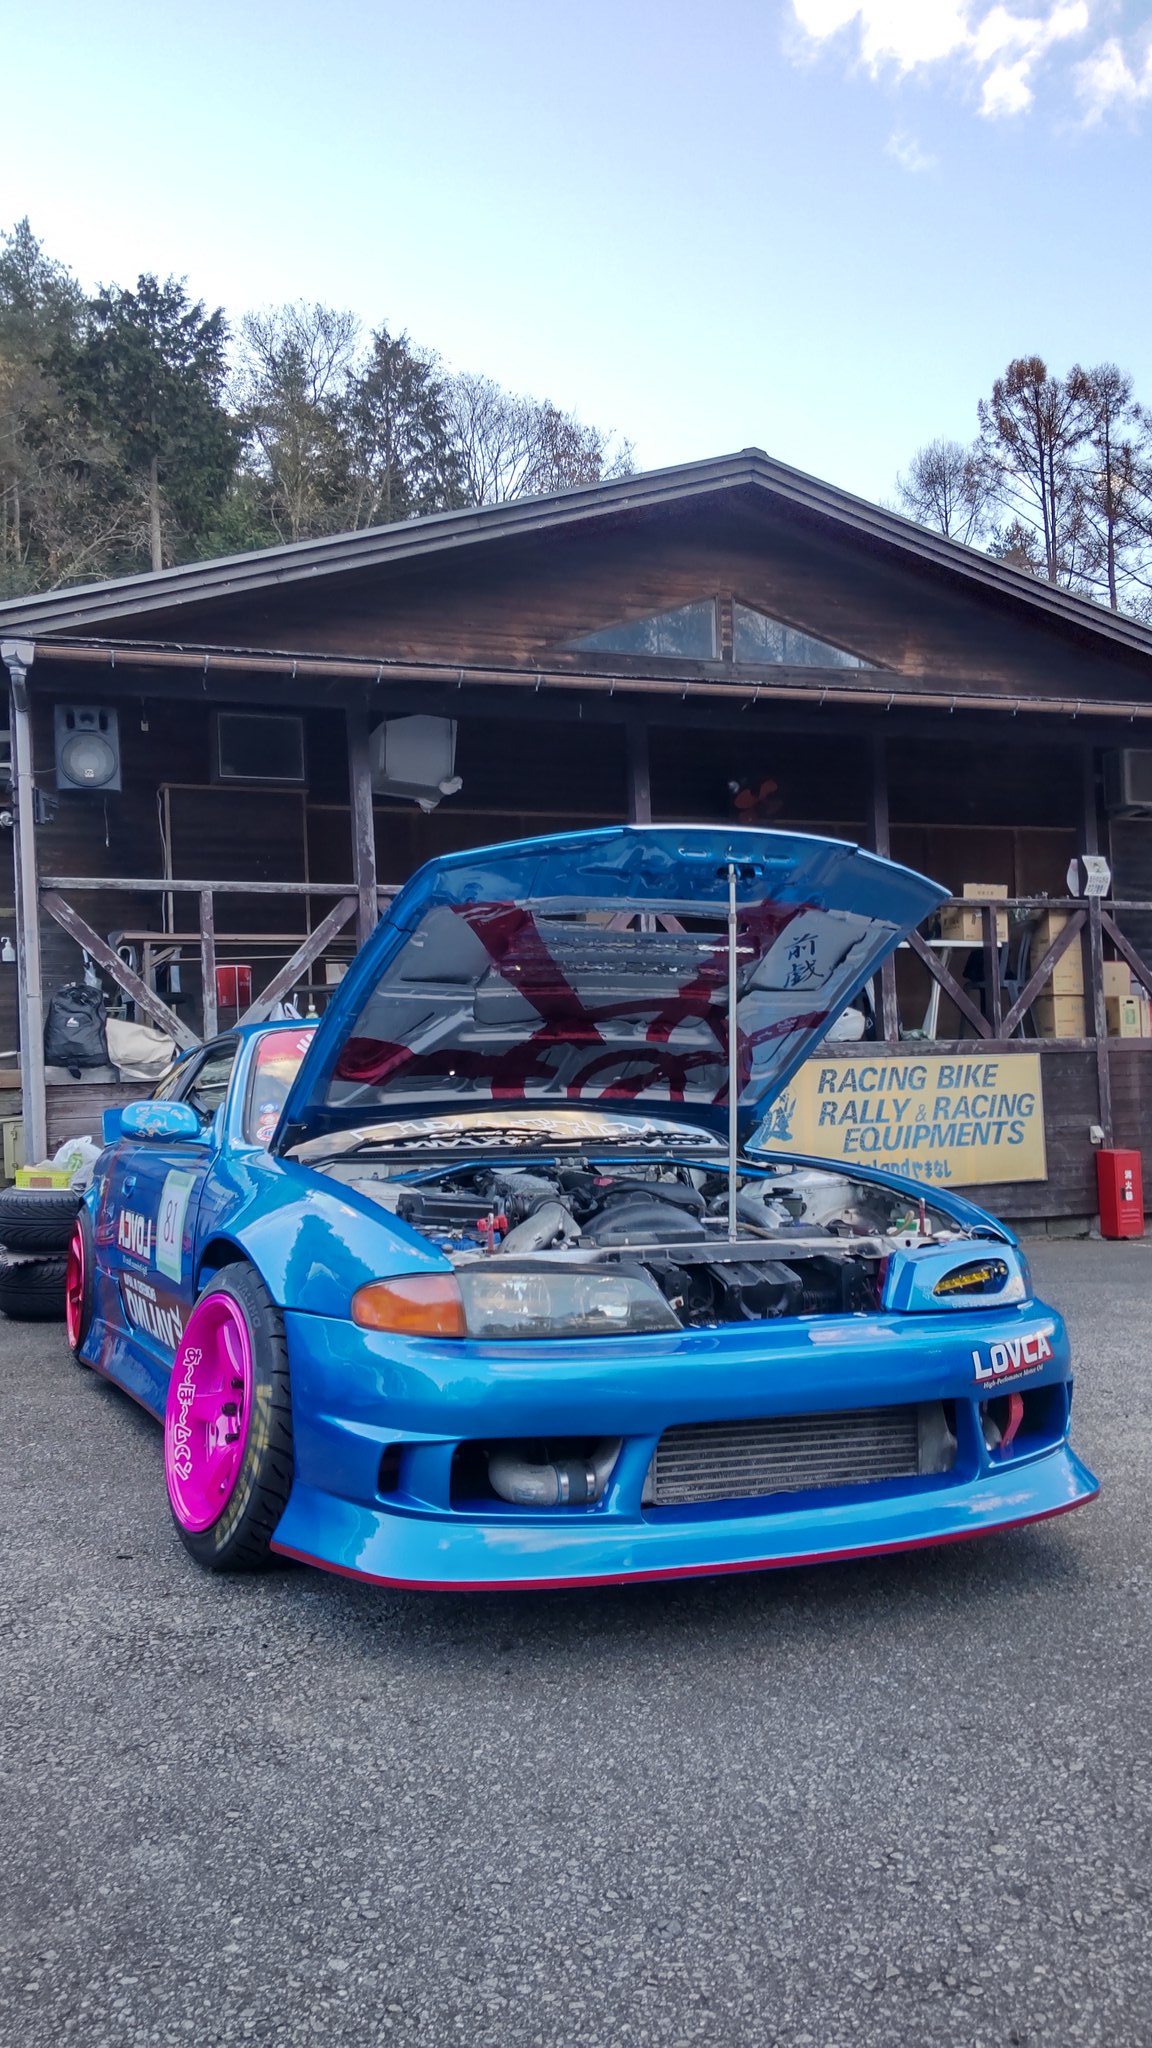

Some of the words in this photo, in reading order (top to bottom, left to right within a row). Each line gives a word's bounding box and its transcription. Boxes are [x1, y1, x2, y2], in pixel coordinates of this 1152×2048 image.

[818, 1065, 928, 1094] RACING
[936, 1063, 999, 1090] BIKE
[818, 1098, 912, 1126] RALLY
[915, 1103, 927, 1122] &
[932, 1093, 1036, 1121] RACING
[843, 1120, 1026, 1153] EQUIPMENTS
[972, 1331, 1051, 1379] LOVCA
